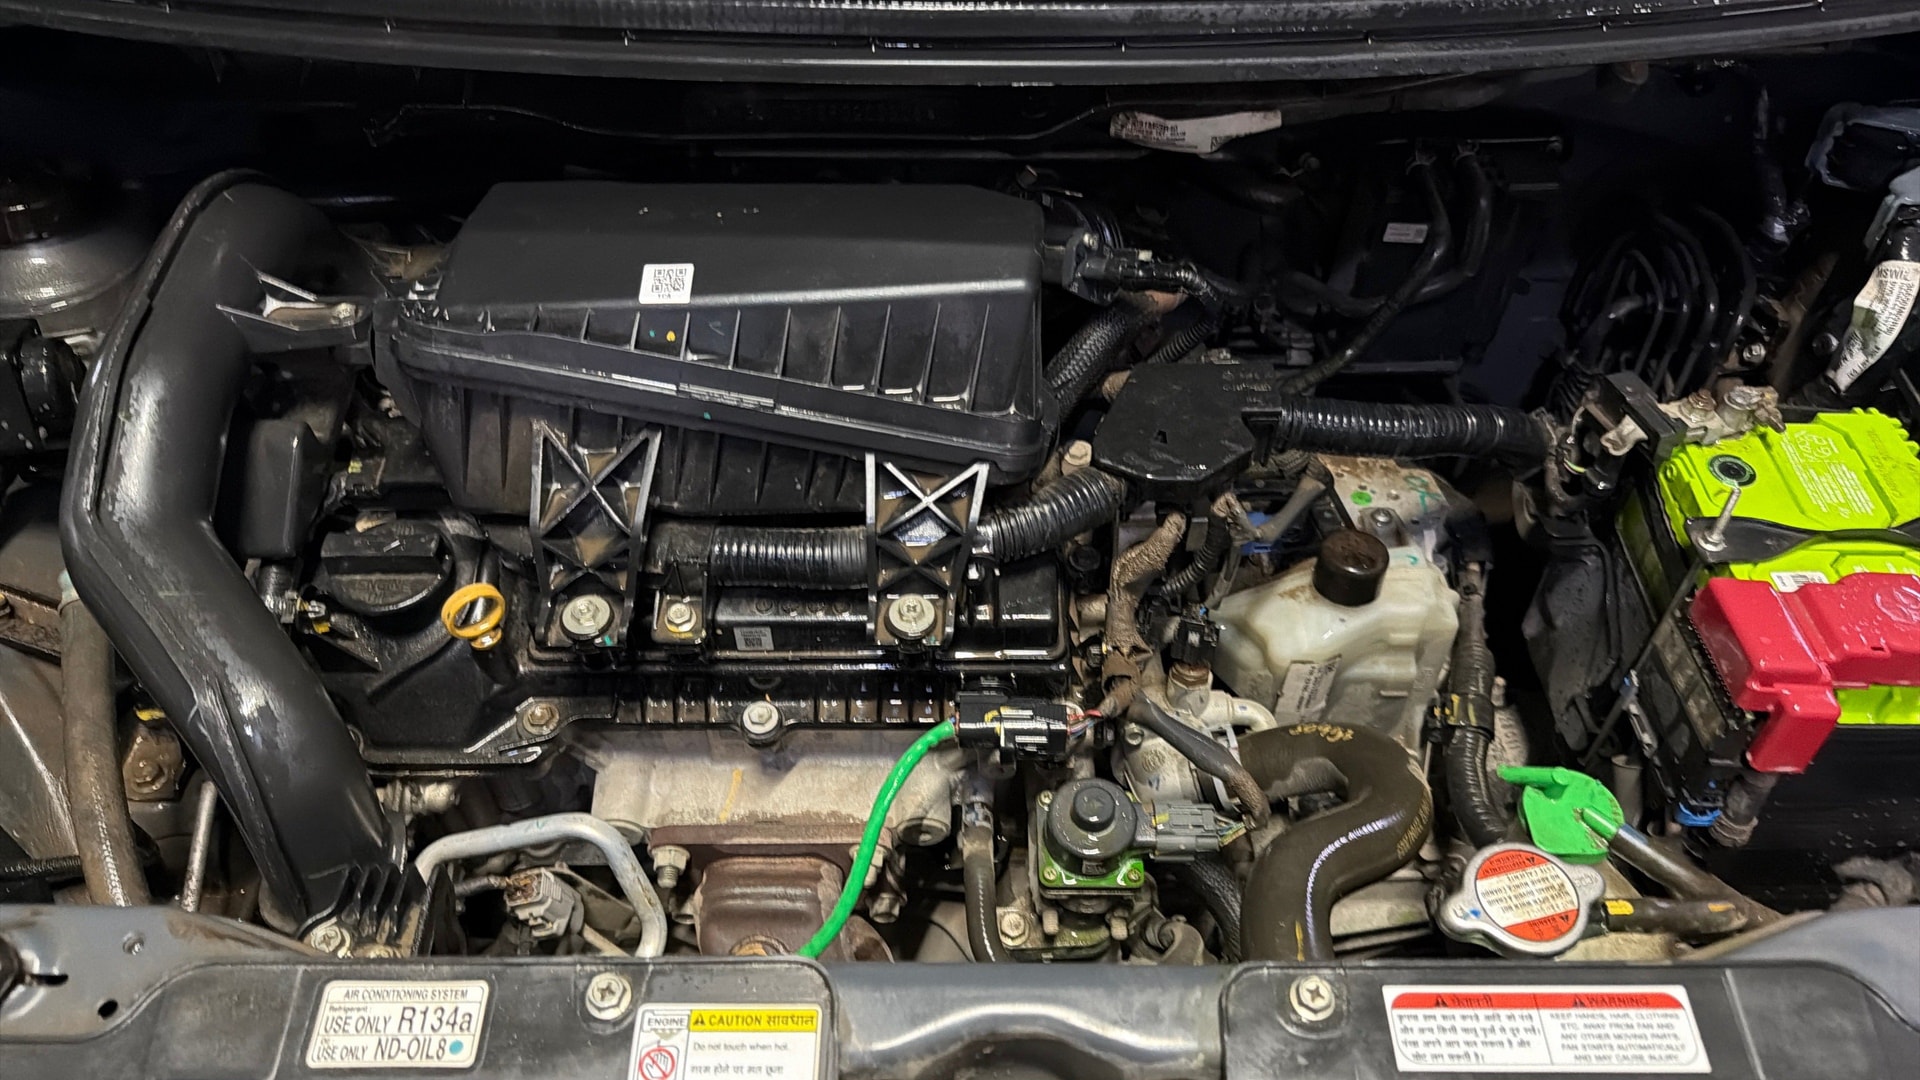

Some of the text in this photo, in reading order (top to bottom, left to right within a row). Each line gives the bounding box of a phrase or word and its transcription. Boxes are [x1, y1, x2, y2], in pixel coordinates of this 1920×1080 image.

[344, 988, 468, 1000] AIR CONDITIONING SYSTEM
[1587, 996, 1649, 1008] WARNING
[324, 1006, 473, 1034] USE ONLY R134a
[647, 1017, 686, 1027] ENGINE
[709, 1014, 815, 1027] CAUTION सावधान
[316, 1038, 447, 1060] USE ONLY ND-OIL8
[693, 1042, 706, 1051] Do
[708, 1042, 722, 1051] not
[723, 1042, 748, 1051] touch
[749, 1042, 772, 1051] when
